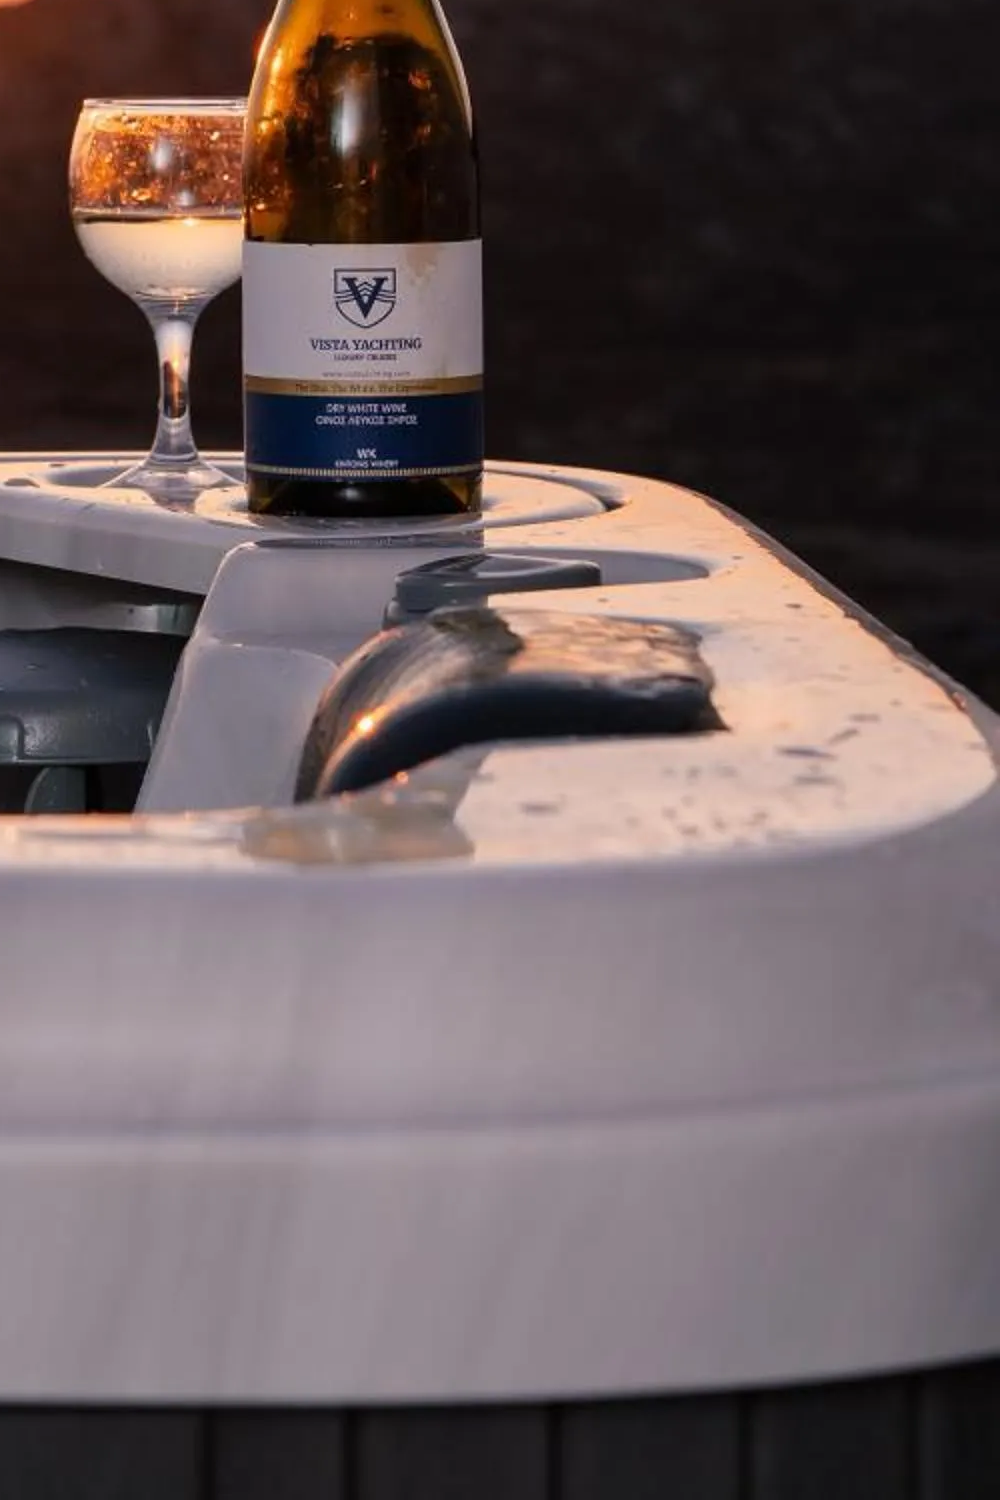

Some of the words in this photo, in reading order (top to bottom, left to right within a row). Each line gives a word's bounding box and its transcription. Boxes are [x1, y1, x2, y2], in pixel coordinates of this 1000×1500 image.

[310, 339, 349, 351] VISTA
[351, 338, 423, 351] YACHTING
[326, 403, 345, 413] DRY
[347, 403, 380, 413] WHITE
[381, 403, 407, 413] WINE
